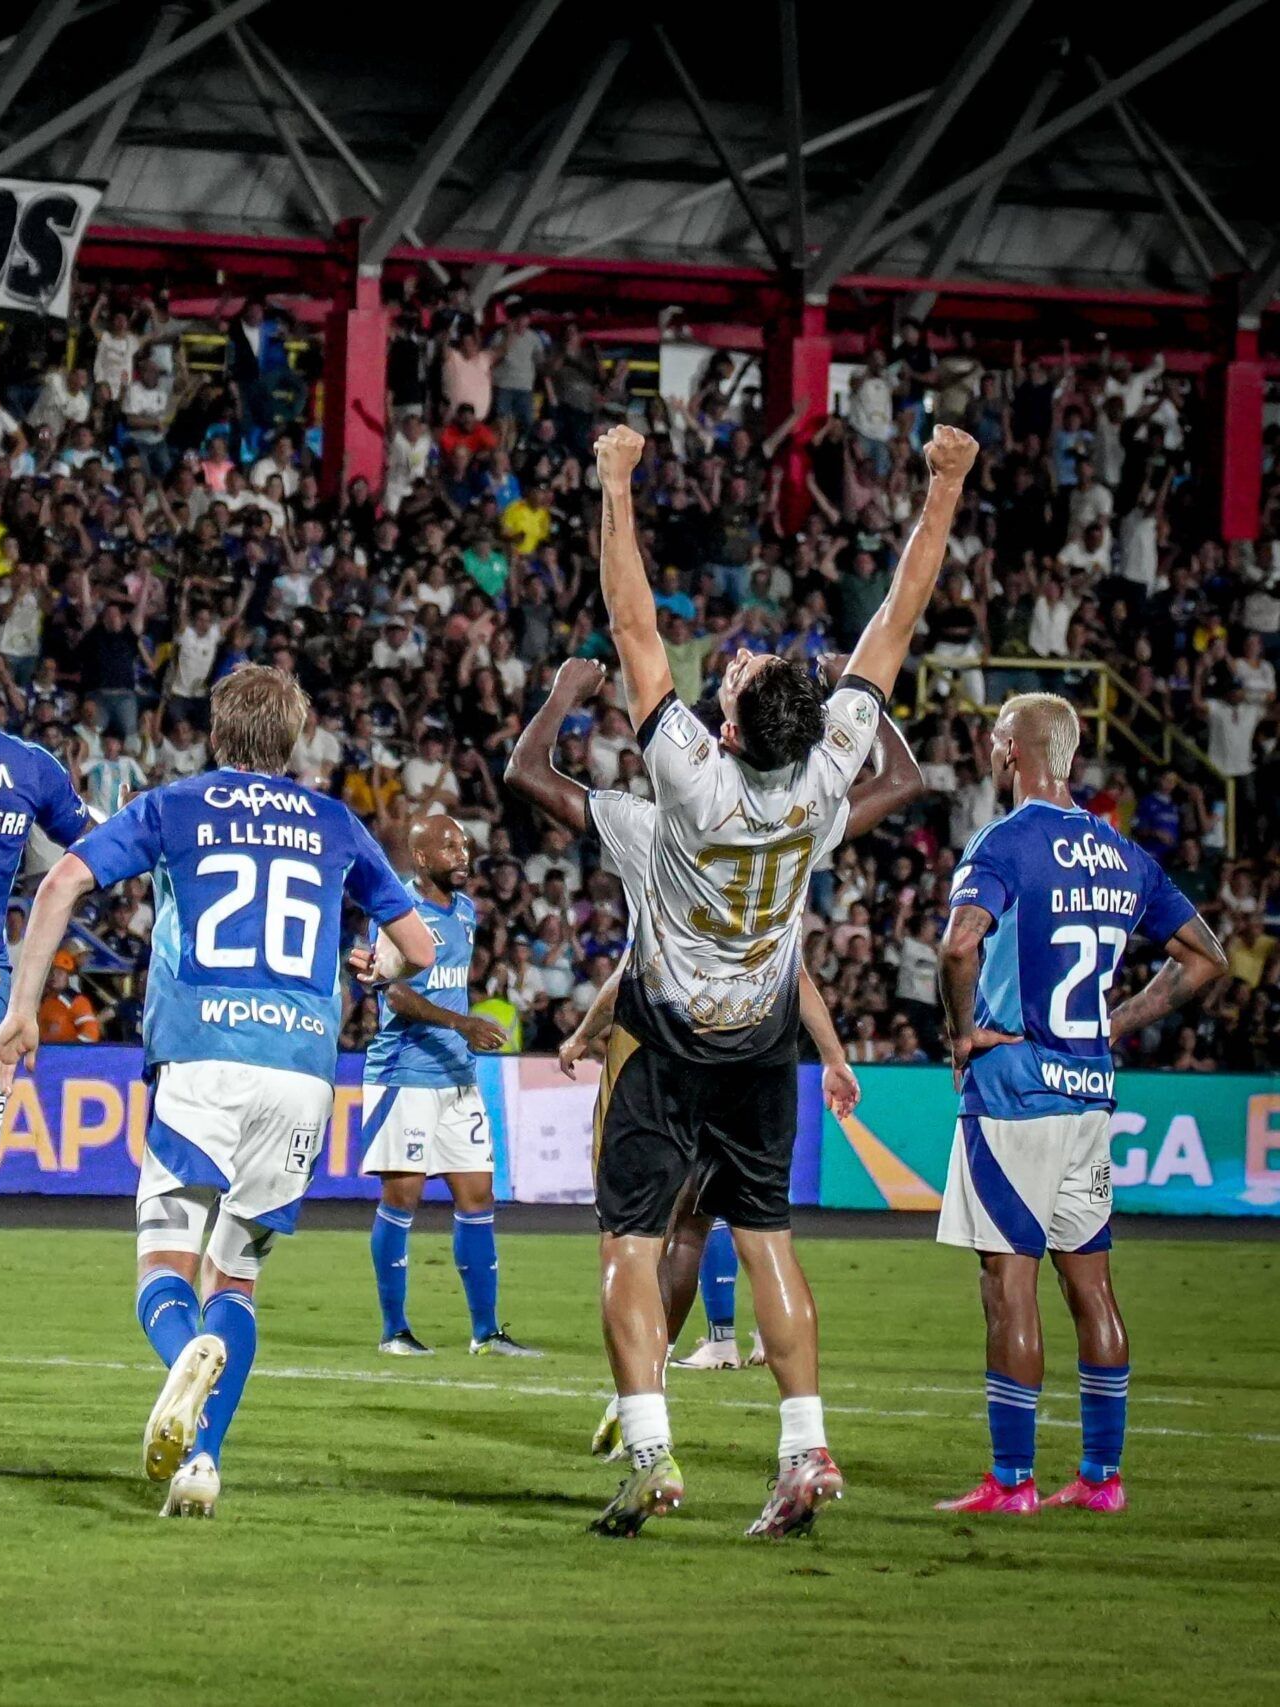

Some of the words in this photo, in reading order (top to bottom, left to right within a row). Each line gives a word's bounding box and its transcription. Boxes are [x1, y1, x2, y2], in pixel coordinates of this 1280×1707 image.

[230, 822, 322, 855] LLINAS
[688, 833, 816, 938] 30
[195, 853, 322, 979] 26
